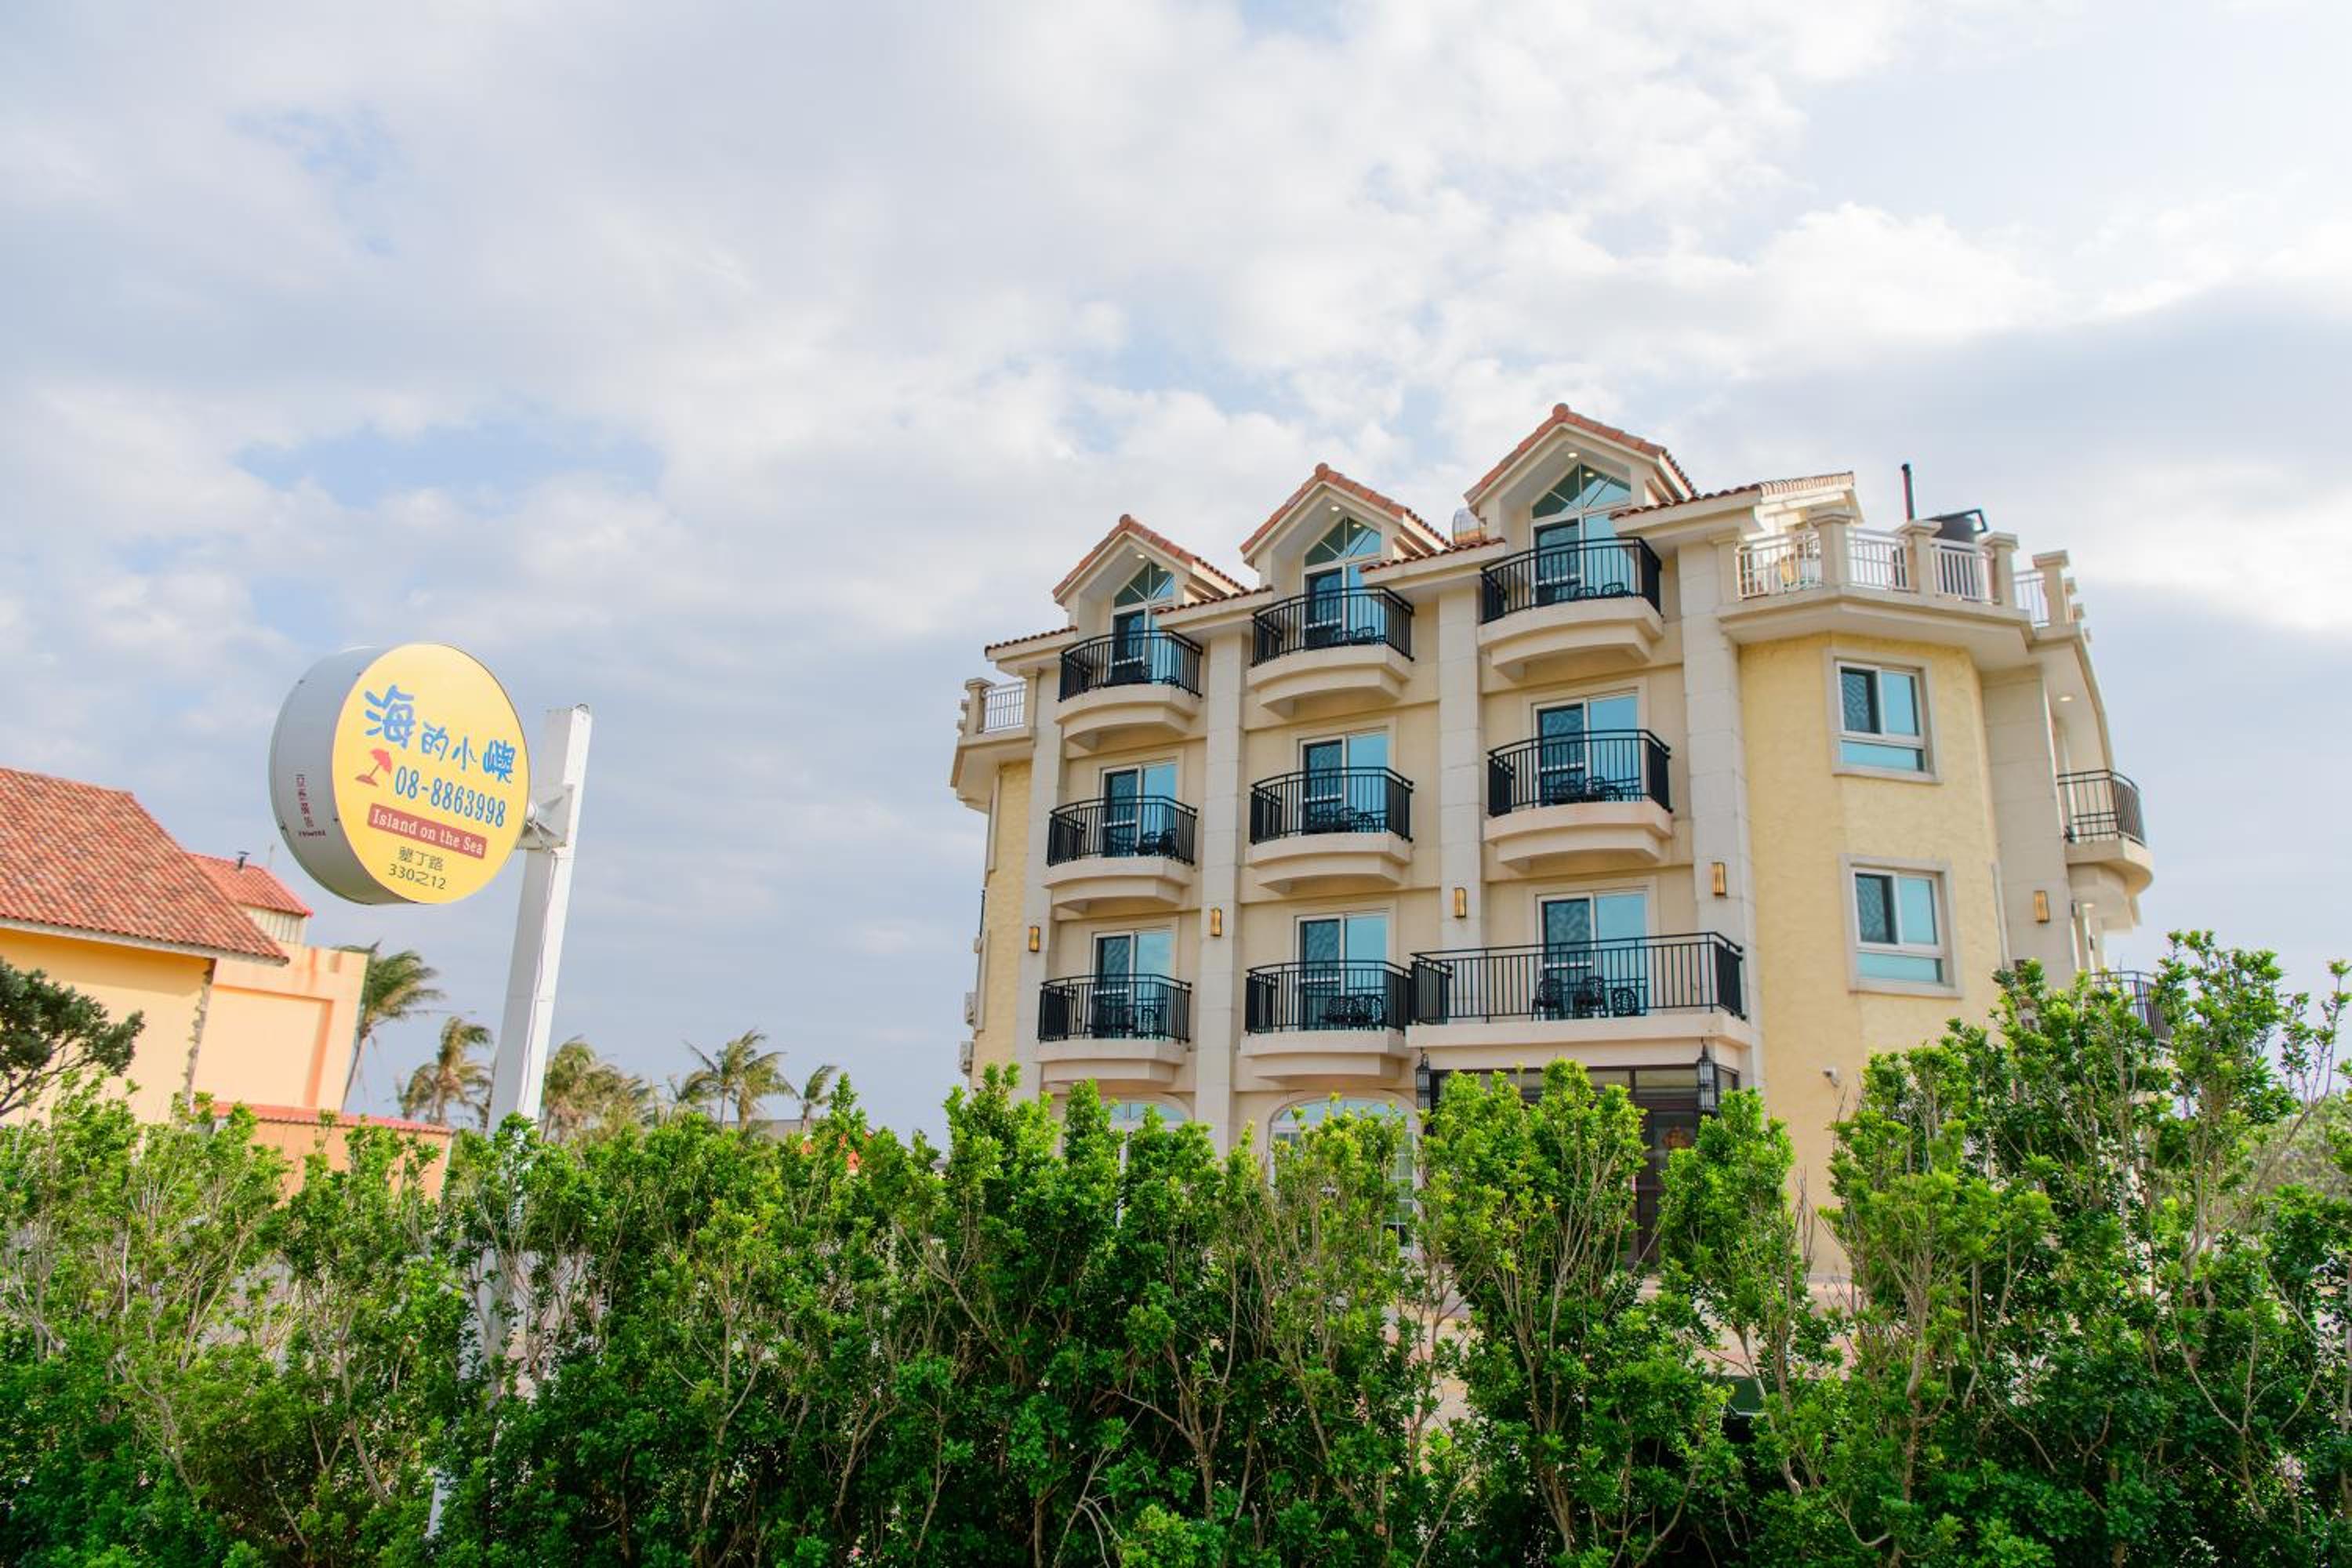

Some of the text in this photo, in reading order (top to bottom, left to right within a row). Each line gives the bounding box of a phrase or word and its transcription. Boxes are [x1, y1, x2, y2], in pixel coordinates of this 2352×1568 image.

[395, 766, 506, 828] 08-8863998
[372, 810, 484, 855] Island on the Sea
[388, 863, 447, 890] 330之12
[398, 847, 444, 871] 墾丁路
